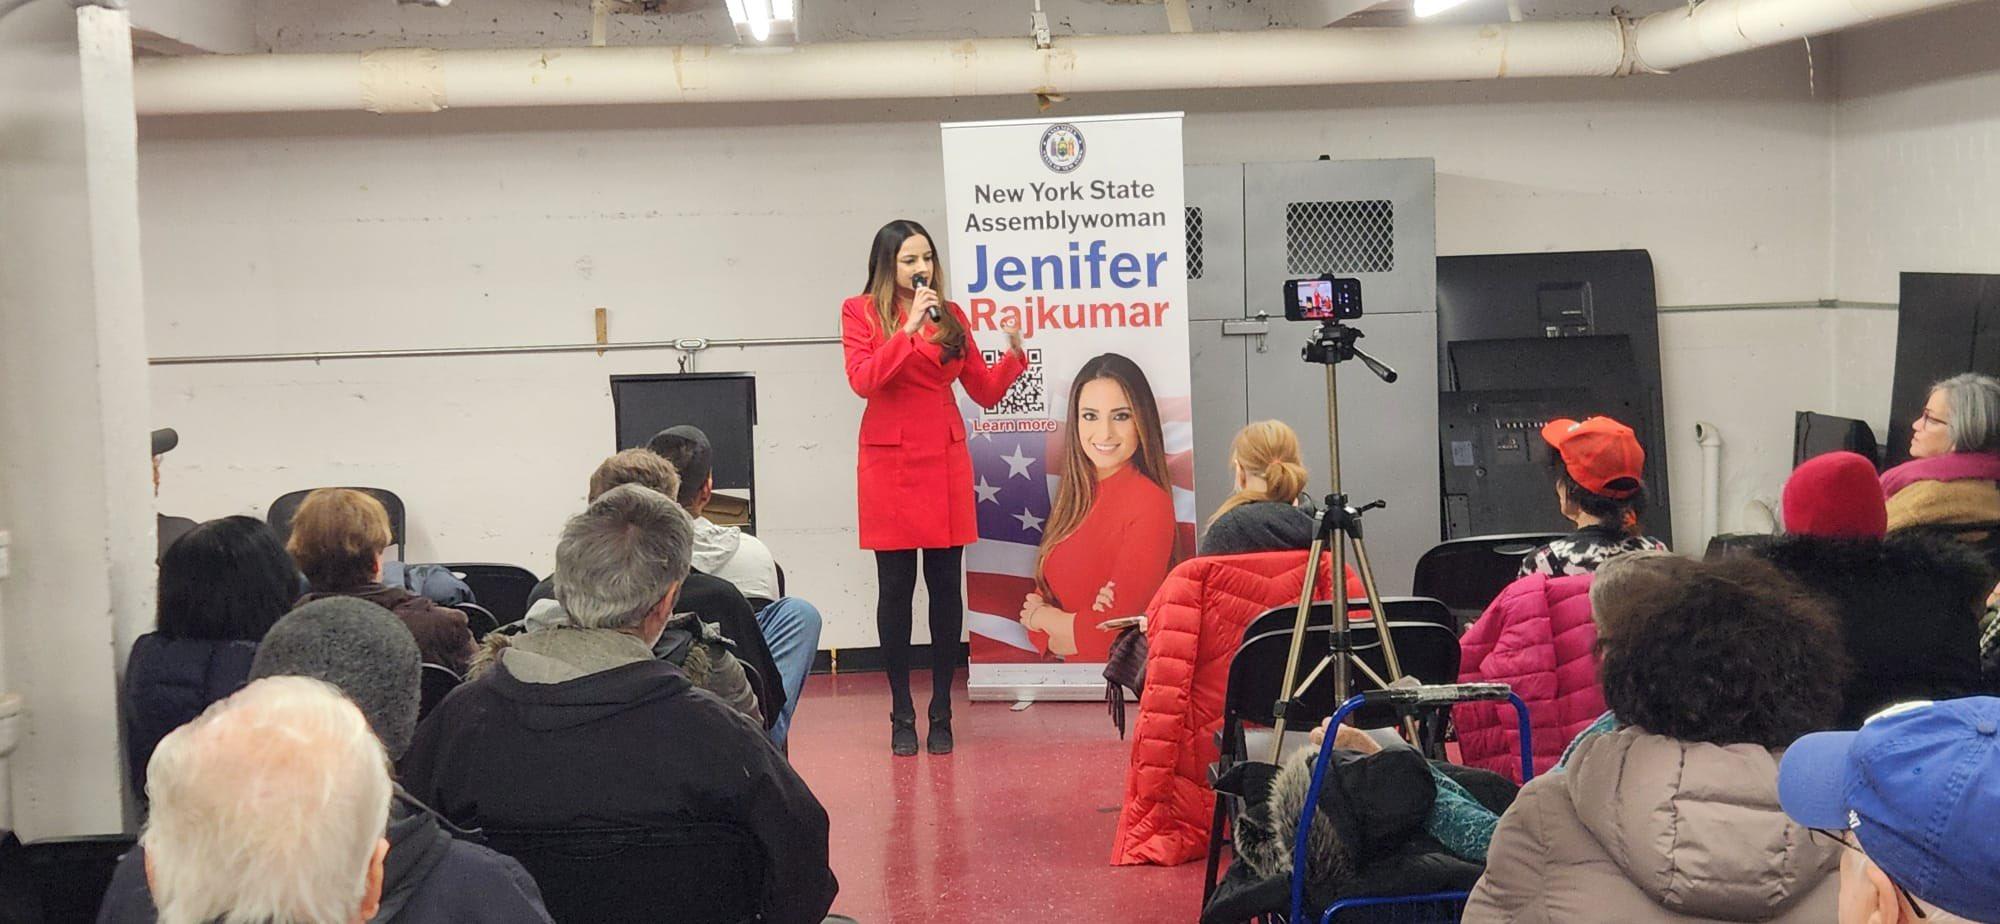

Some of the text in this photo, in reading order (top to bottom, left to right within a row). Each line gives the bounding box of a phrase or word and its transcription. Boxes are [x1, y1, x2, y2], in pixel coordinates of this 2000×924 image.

[974, 180, 1155, 204] New York State
[965, 210, 1166, 234] Assemblywoman
[968, 240, 1168, 293] Jenifer
[970, 296, 1170, 339] Rajkumar
[973, 419, 1056, 432] Learn more
